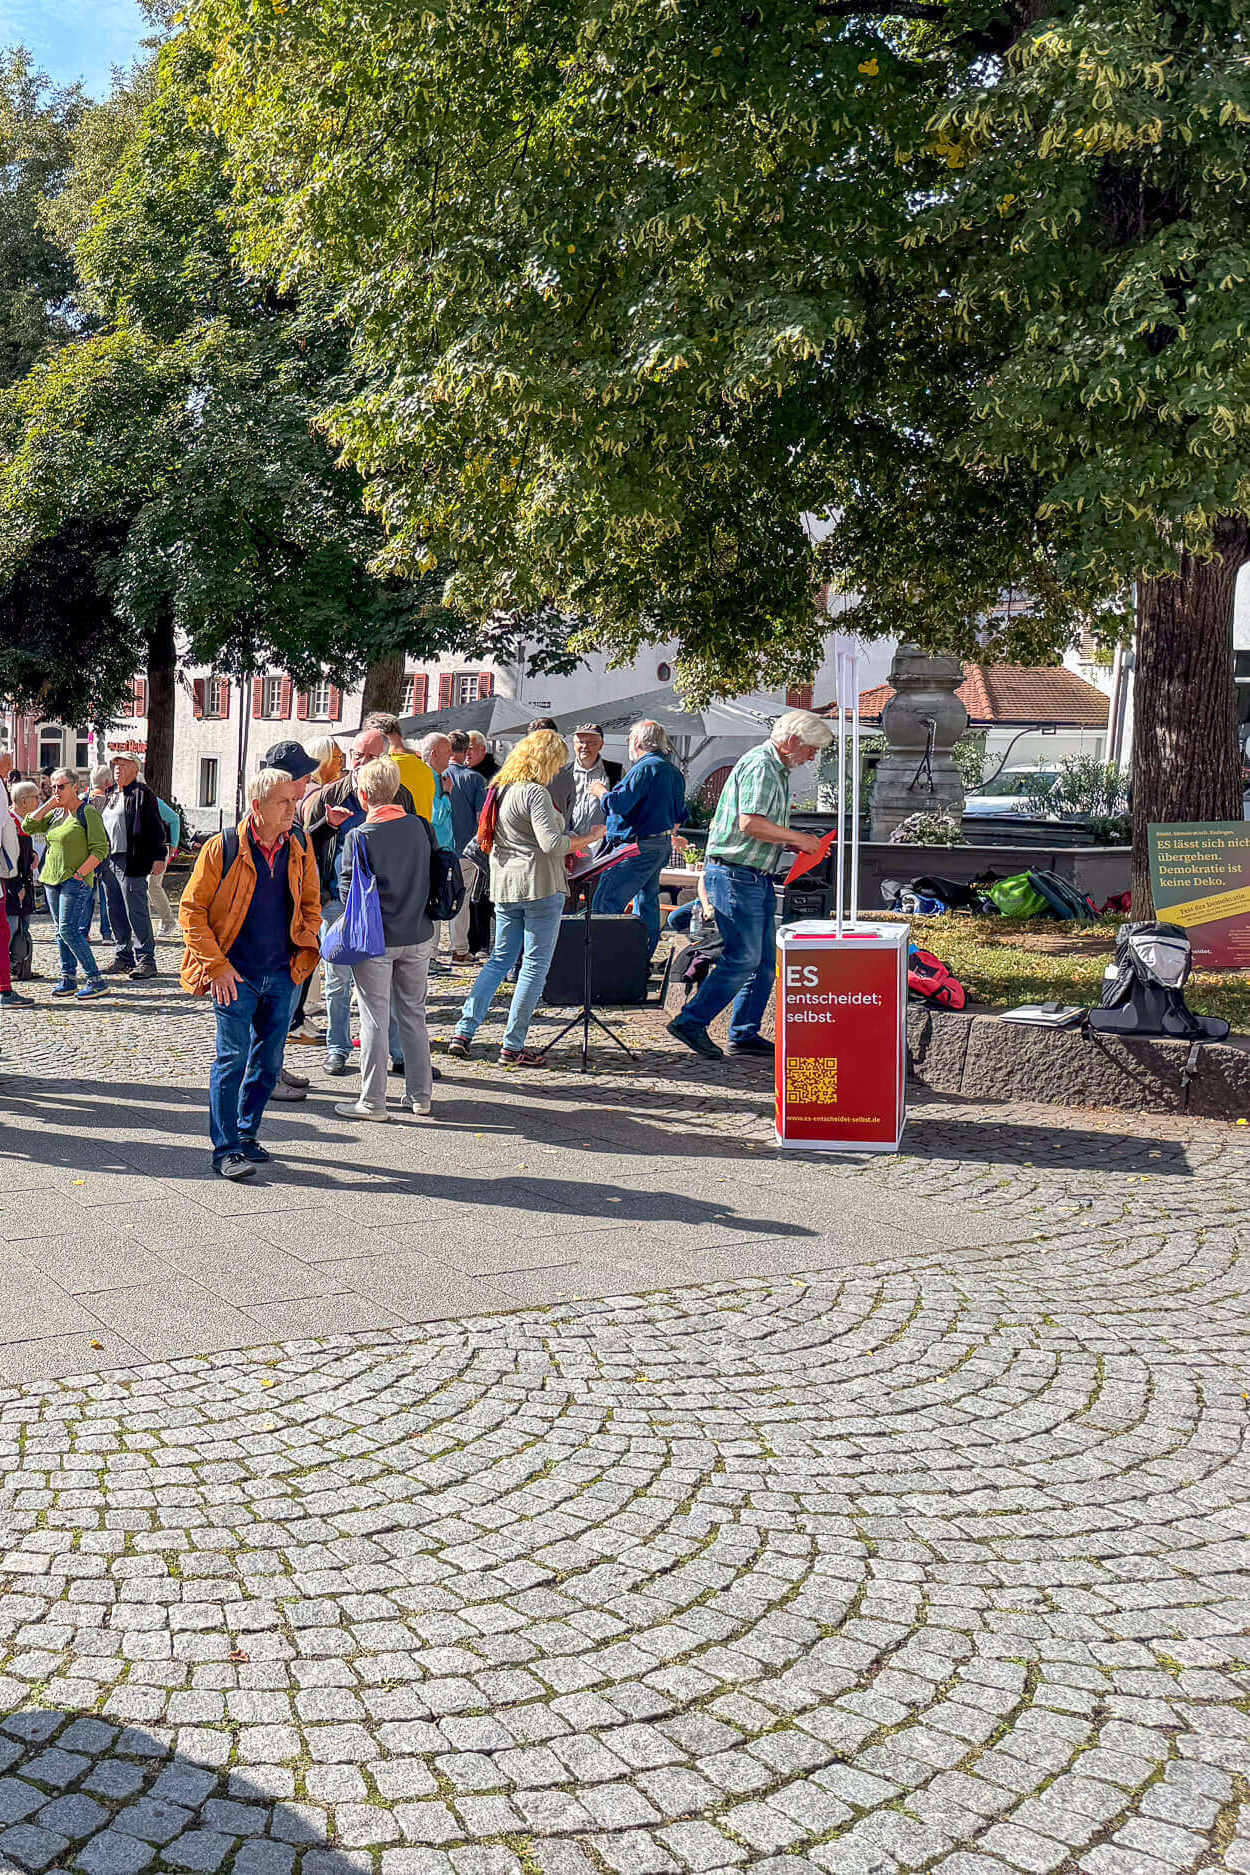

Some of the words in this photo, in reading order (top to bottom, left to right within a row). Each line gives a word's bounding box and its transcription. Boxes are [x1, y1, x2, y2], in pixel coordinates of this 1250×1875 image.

[1158, 840, 1171, 849] ES
[1174, 839, 1199, 848] lässt
[1202, 839, 1225, 848] sich
[1158, 852, 1222, 863] übergehen.
[1159, 864, 1225, 874] Demokratie
[1228, 864, 1243, 873] ist
[1160, 877, 1191, 887] keine
[1193, 876, 1226, 886] Deko.
[786, 966, 819, 987] ES
[787, 992, 882, 1006] entscheidet;
[787, 1010, 836, 1023] selbst.
